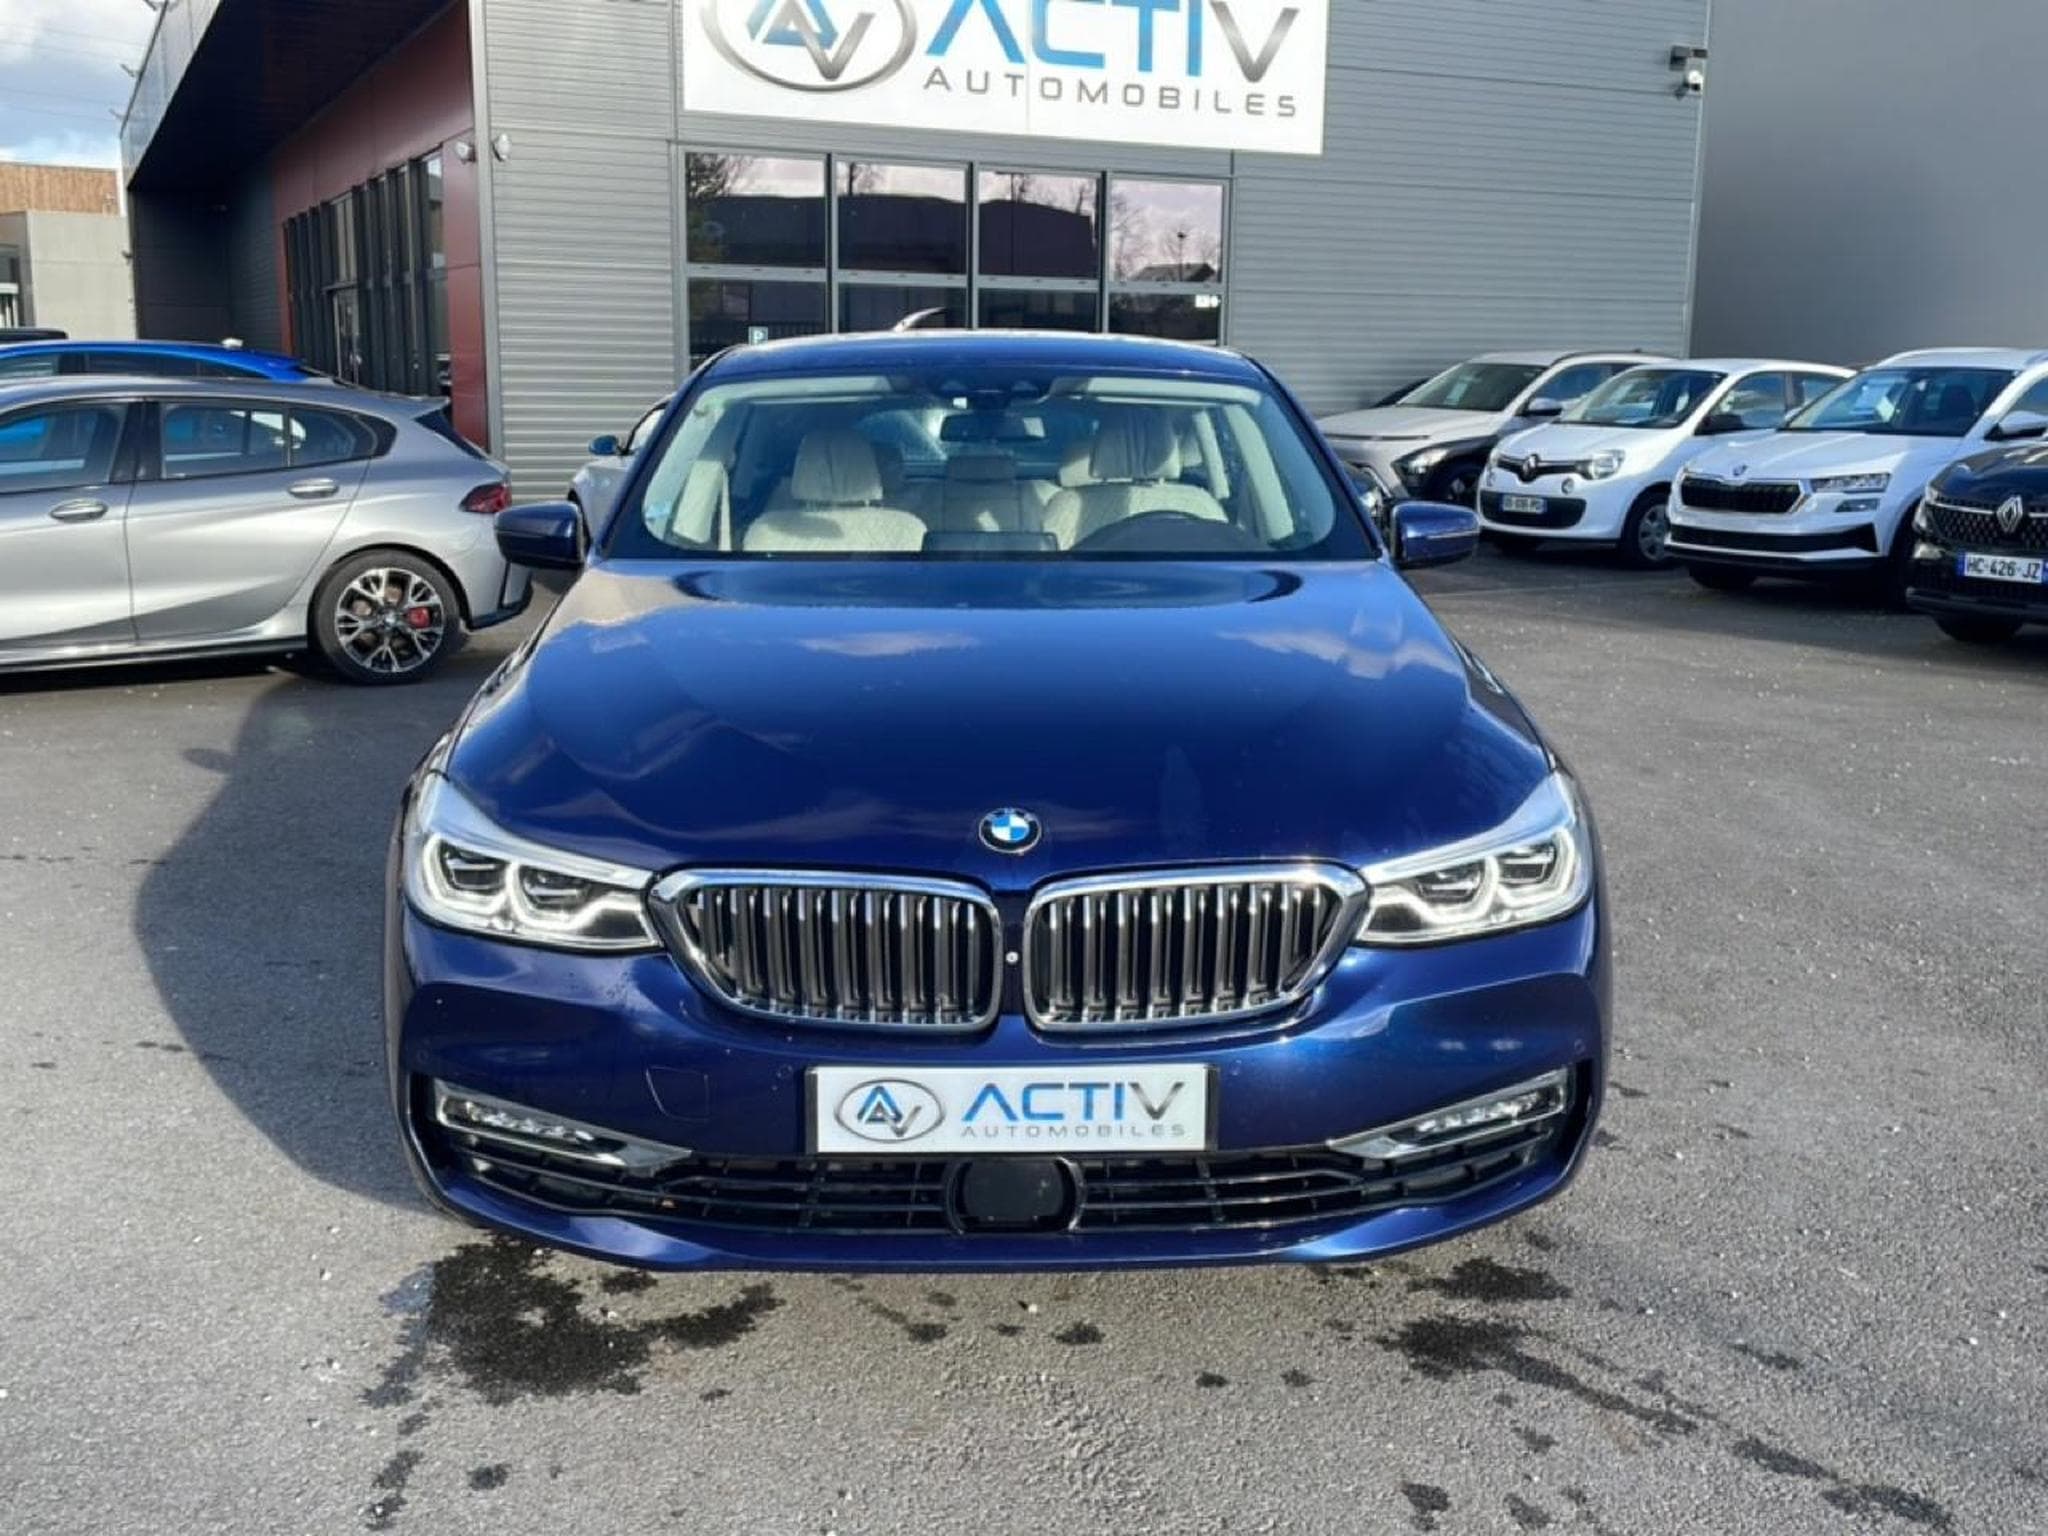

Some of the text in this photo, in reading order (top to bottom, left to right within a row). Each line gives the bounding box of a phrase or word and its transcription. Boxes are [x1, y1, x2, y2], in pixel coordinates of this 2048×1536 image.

[925, 0, 1299, 83] ACTIV
[923, 66, 1297, 117] AUTOMOBILES
[962, 1083, 1185, 1121] ACTIV
[961, 1125, 1185, 1138] AUTOMOBILES
